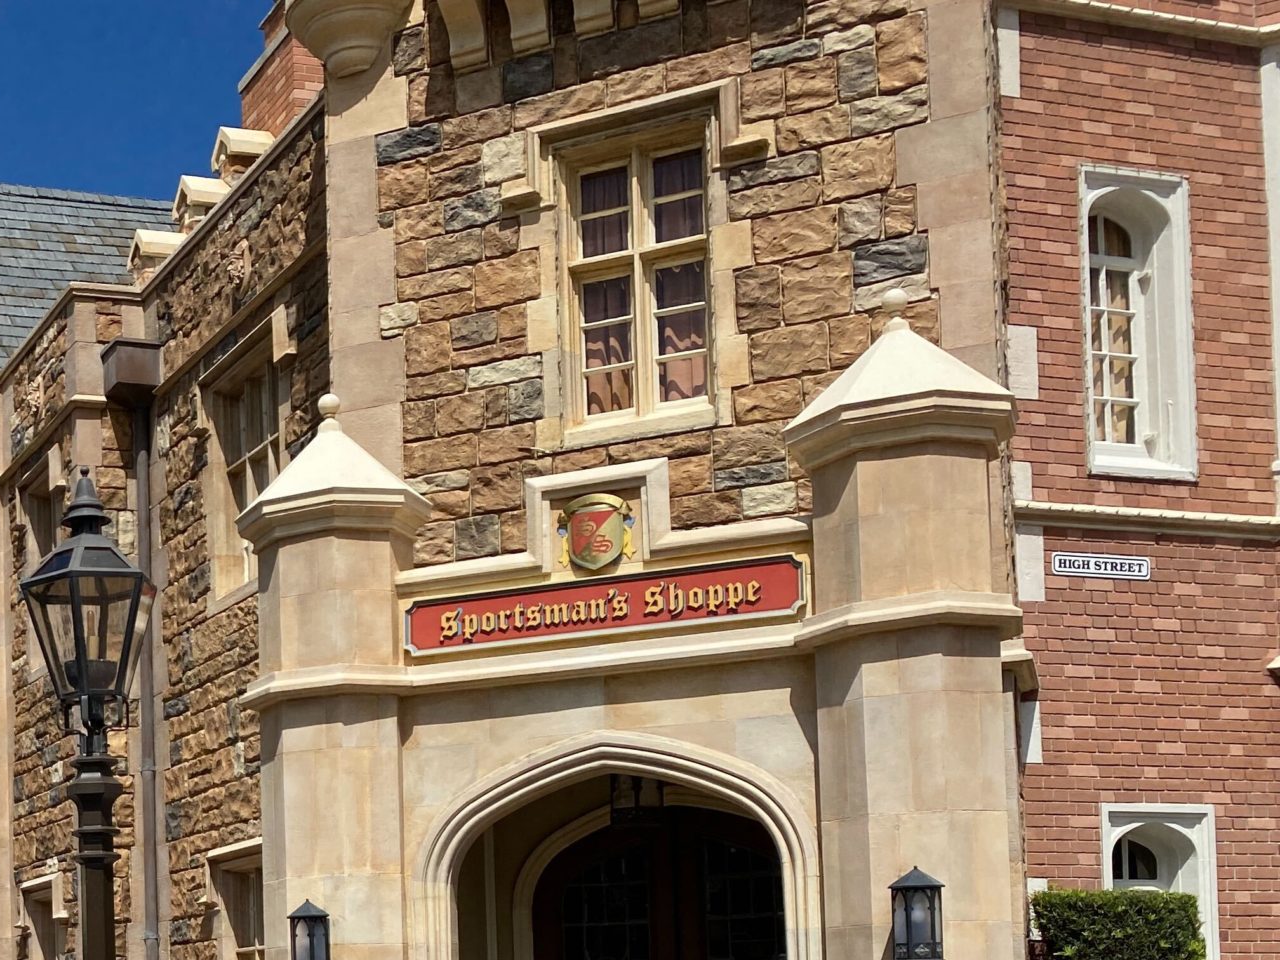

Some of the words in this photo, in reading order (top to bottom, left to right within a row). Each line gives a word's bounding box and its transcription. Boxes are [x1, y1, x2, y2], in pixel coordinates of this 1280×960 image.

[1058, 558, 1091, 570] HIGH
[1094, 561, 1144, 573] STREET
[439, 588, 629, 643] Sportsman's
[644, 578, 762, 617] Shoppe
